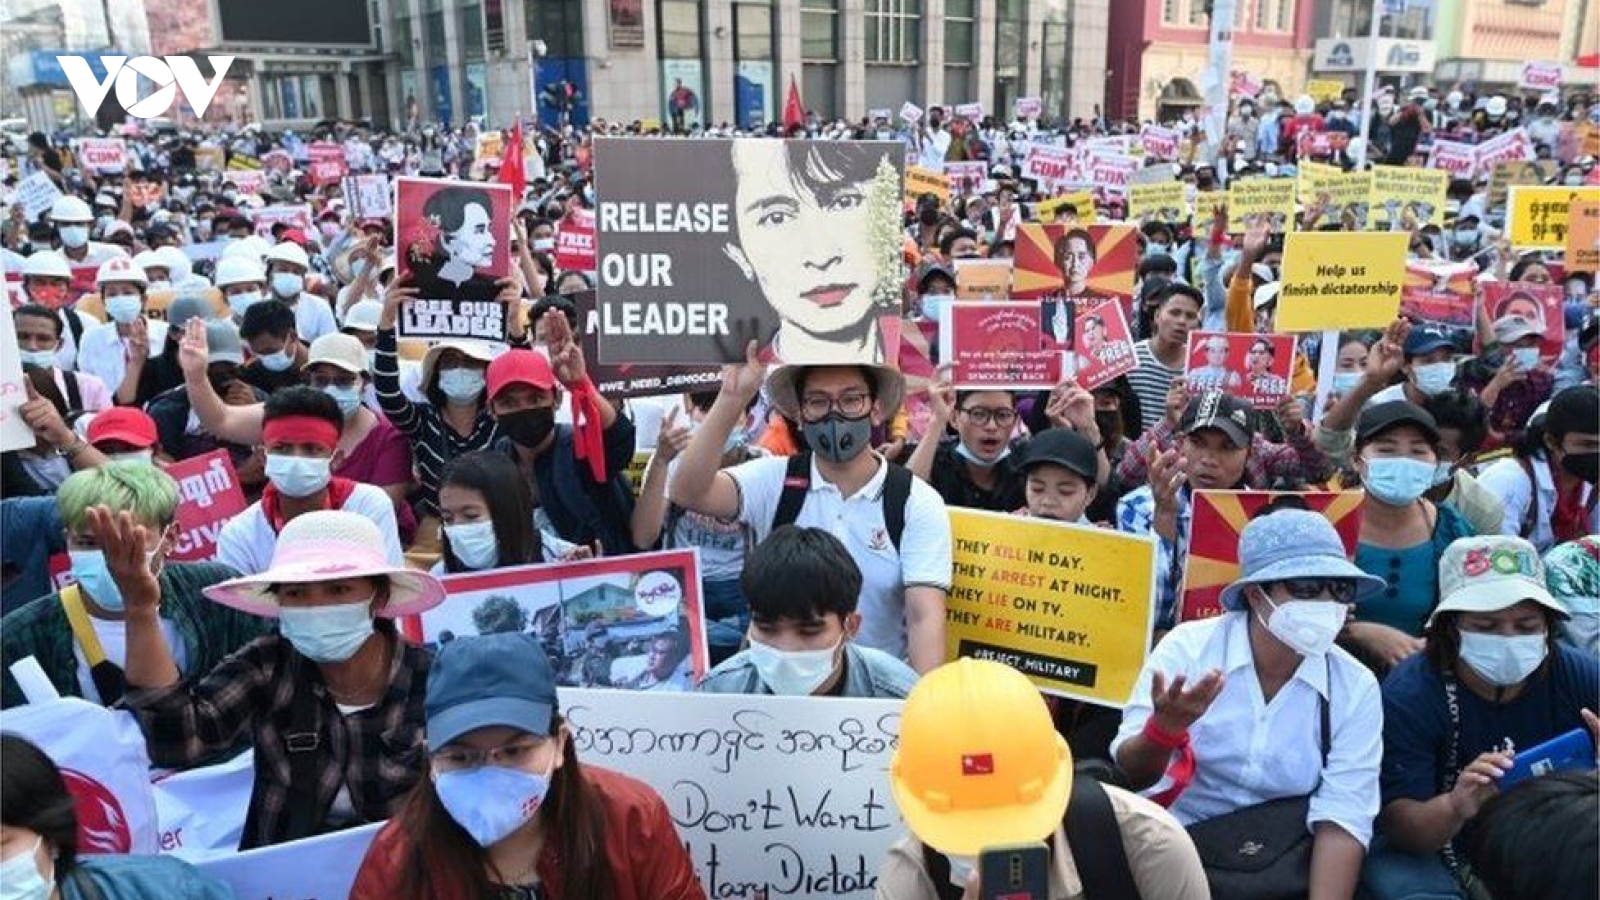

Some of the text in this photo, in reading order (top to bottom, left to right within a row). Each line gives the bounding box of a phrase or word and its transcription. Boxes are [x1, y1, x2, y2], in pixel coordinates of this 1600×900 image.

[1030, 160, 1067, 178] CDM
[600, 202, 729, 233] RELEASE
[560, 232, 593, 248] FREE
[602, 252, 674, 287] OUR
[1316, 264, 1366, 279] Help us
[1283, 281, 1399, 297] finish dictatorship
[402, 299, 502, 319] FREE OUR
[603, 302, 730, 335] LEADER
[403, 313, 503, 339] LEADER
[1189, 377, 1223, 393] FREE
[956, 538, 1084, 571] THEY KILL IN DAY.
[952, 562, 1126, 603] THEY ARREST AT NIGHT.
[948, 586, 1064, 618] THEY LIE ON TV.
[946, 607, 1091, 648] THEY ARE MILITARY.
[672, 780, 891, 833] Don't Want
